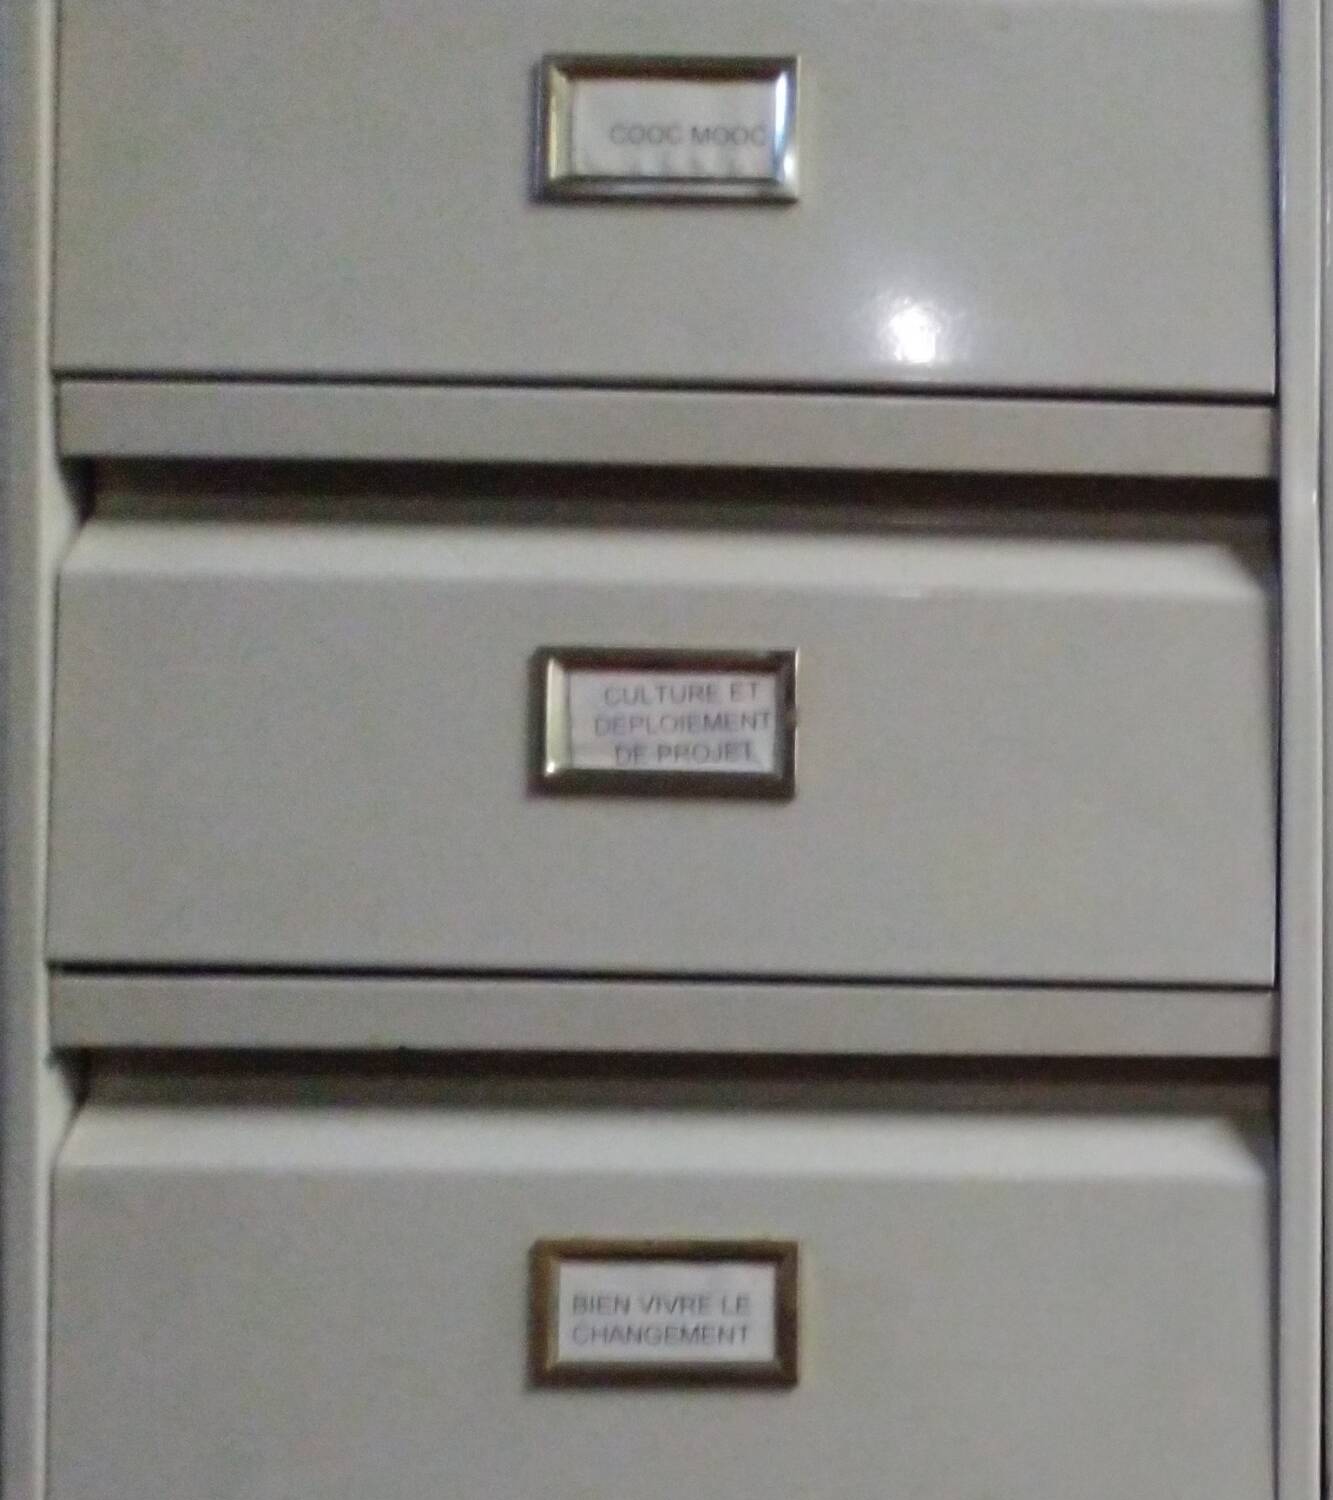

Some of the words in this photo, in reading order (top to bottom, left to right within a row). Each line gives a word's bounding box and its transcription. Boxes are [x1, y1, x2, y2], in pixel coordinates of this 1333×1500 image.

[604, 682, 718, 705] CULTURE
[729, 680, 760, 701] ET
[614, 743, 645, 766] DE
[657, 740, 752, 764] PROJET
[572, 1294, 630, 1316] BIEN
[641, 1294, 711, 1316] VIVRE
[721, 1294, 751, 1316] LE
[572, 1325, 750, 1347] CHANGEMENT
